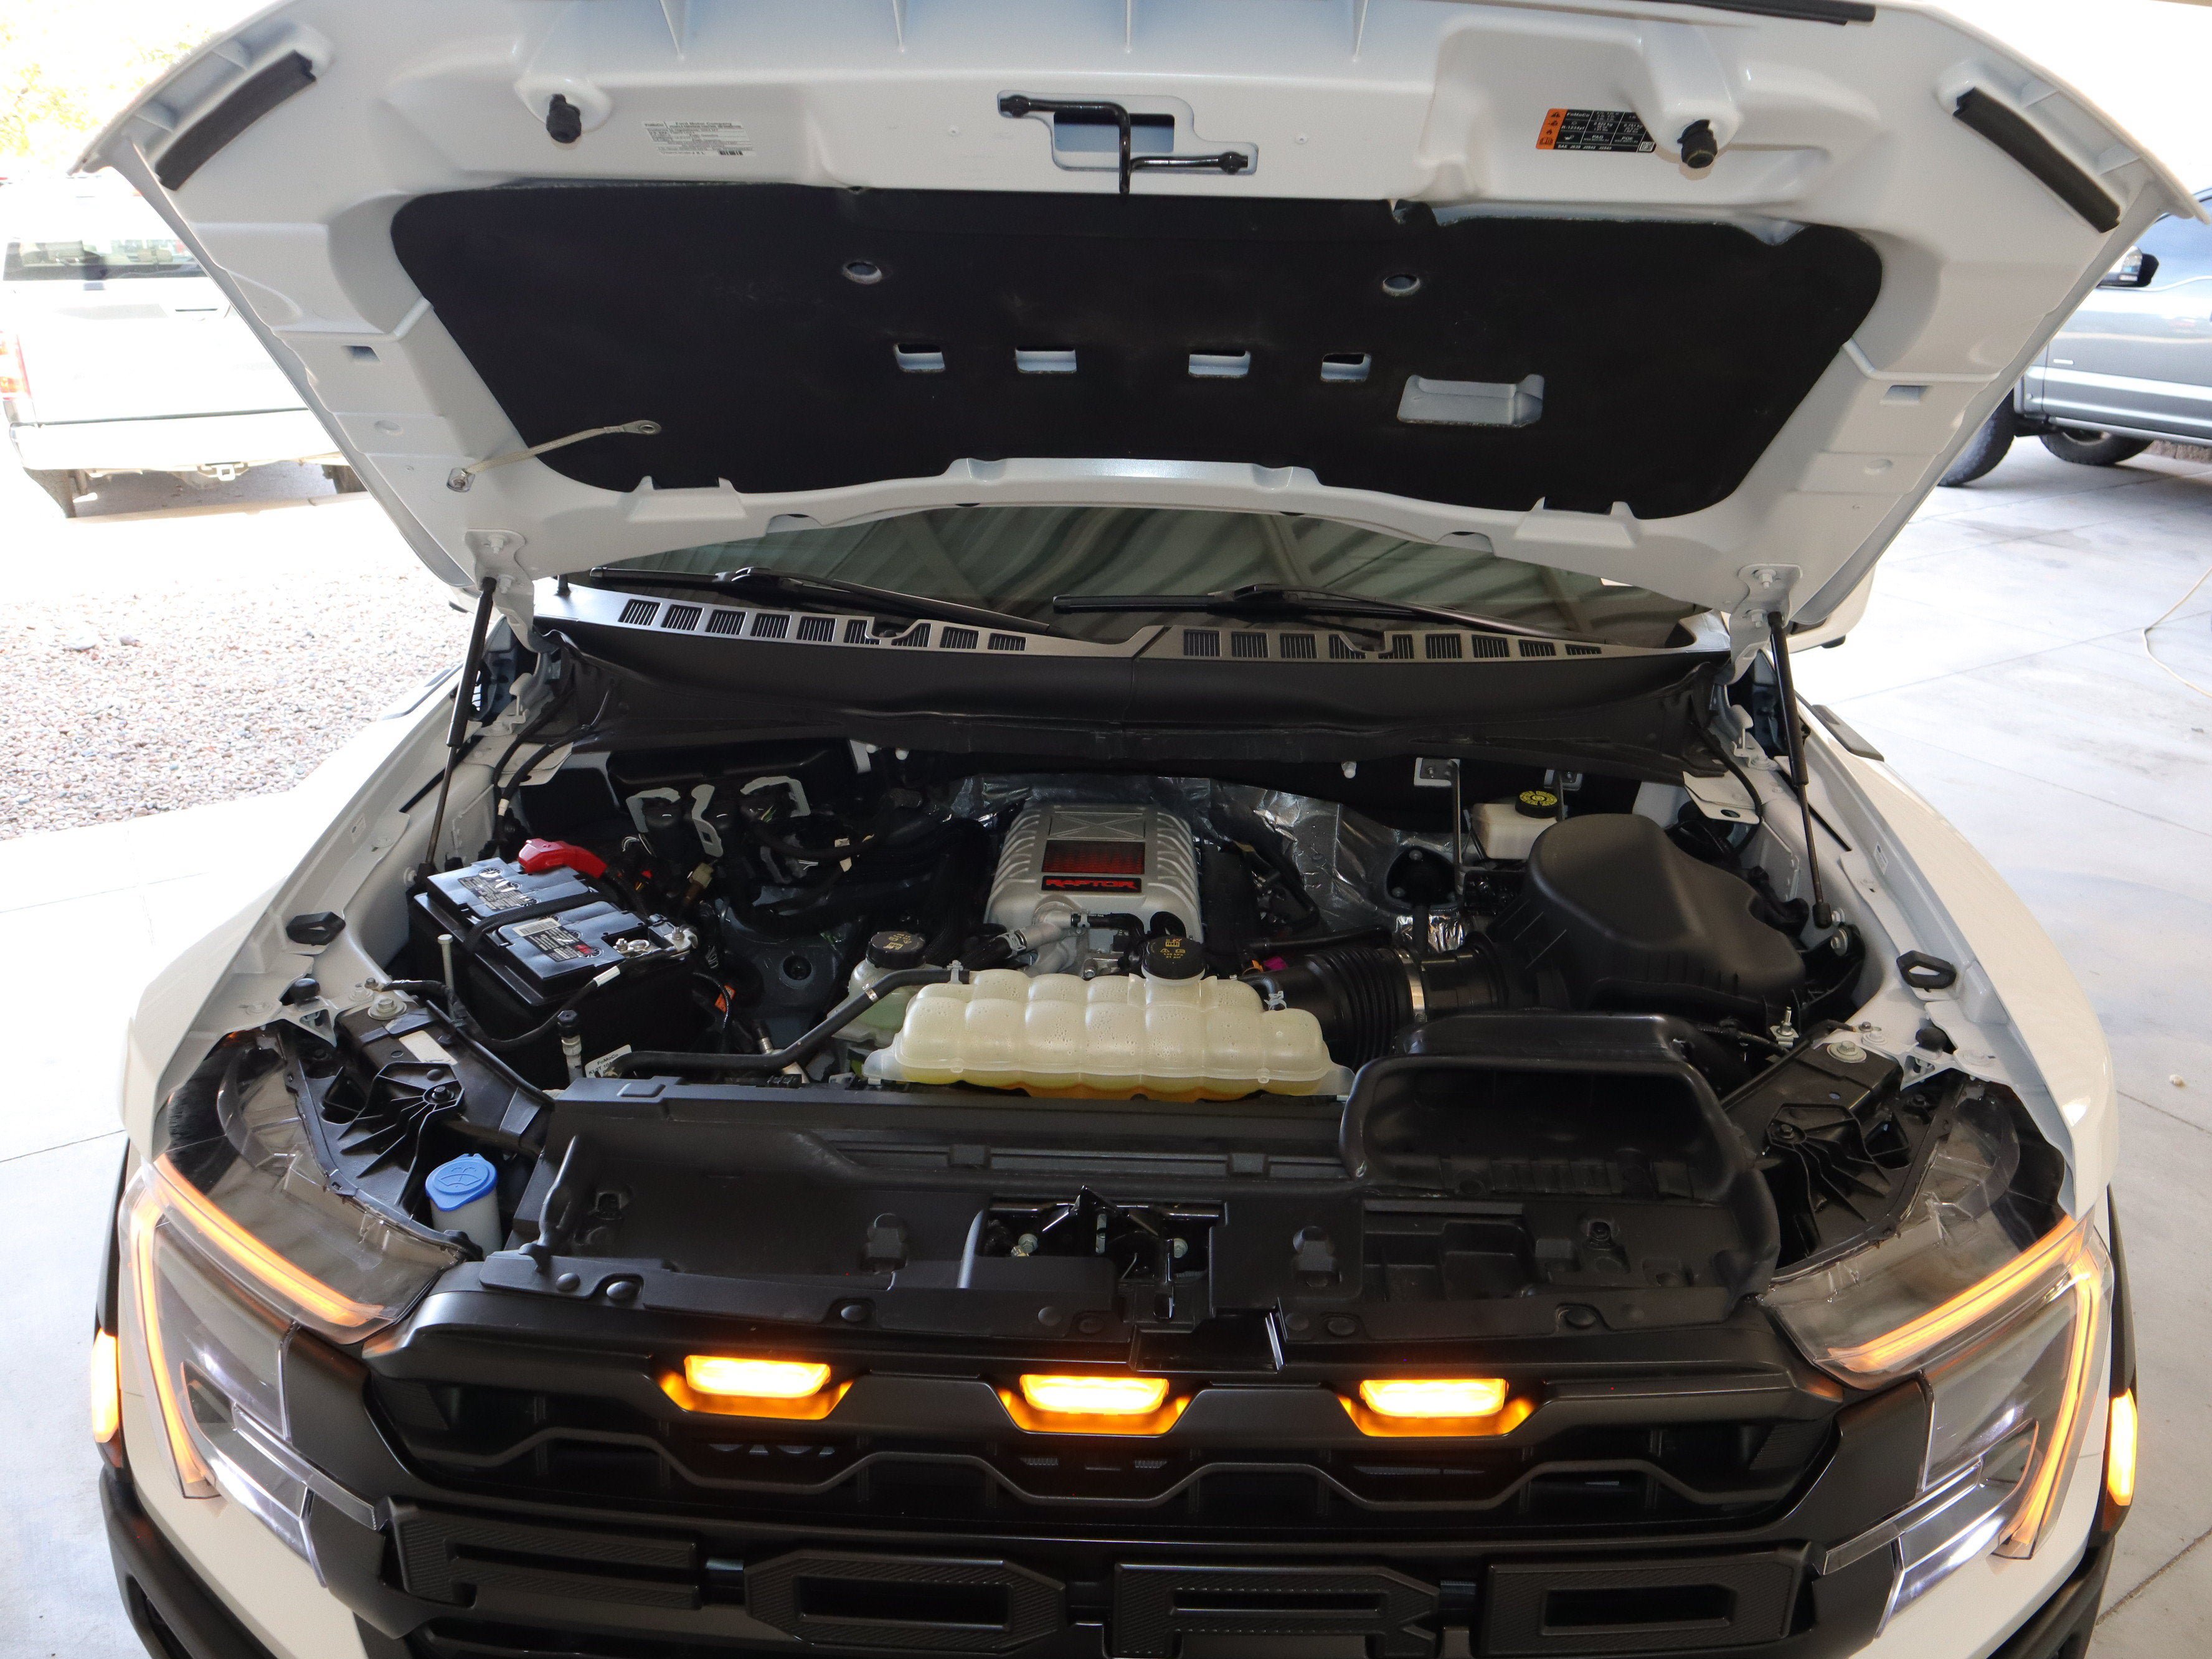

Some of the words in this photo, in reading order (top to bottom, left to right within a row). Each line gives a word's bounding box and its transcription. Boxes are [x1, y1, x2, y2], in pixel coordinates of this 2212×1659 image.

[1046, 879, 1138, 890] RAPTOR
[597, 1054, 619, 1066] FoMoCo
[387, 1496, 1812, 1659] FORD
